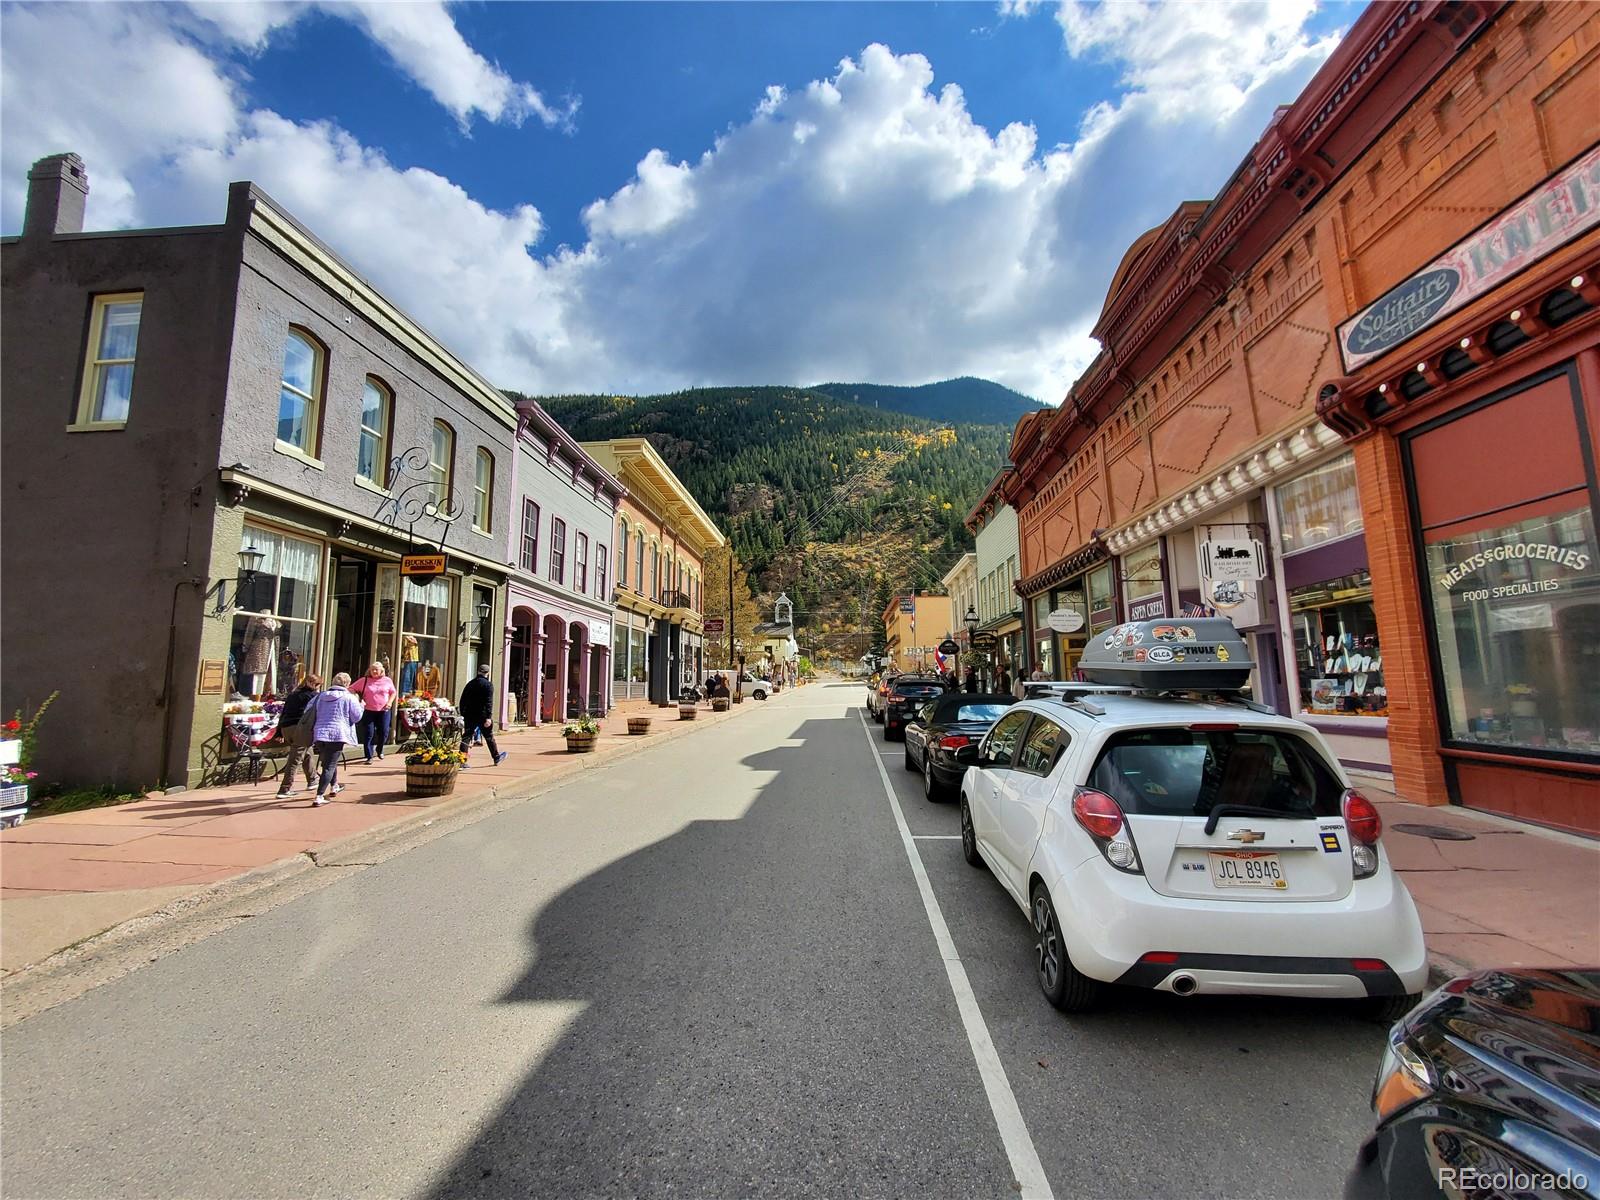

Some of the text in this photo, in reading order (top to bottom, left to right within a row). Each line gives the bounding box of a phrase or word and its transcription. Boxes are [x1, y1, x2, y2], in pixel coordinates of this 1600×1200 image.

[1358, 272, 1450, 348] Solitaire
[404, 558, 442, 567] BUCKSKIN
[1440, 552, 1485, 590] MEATS
[1494, 542, 1590, 572] GROCERIES
[1462, 578, 1560, 602] FOOD SPECIALTIES
[1131, 599, 1164, 620] ASPEN CREEK
[1184, 646, 1216, 655] THULE
[1219, 860, 1243, 879] JCL
[1246, 861, 1281, 880] 8946
